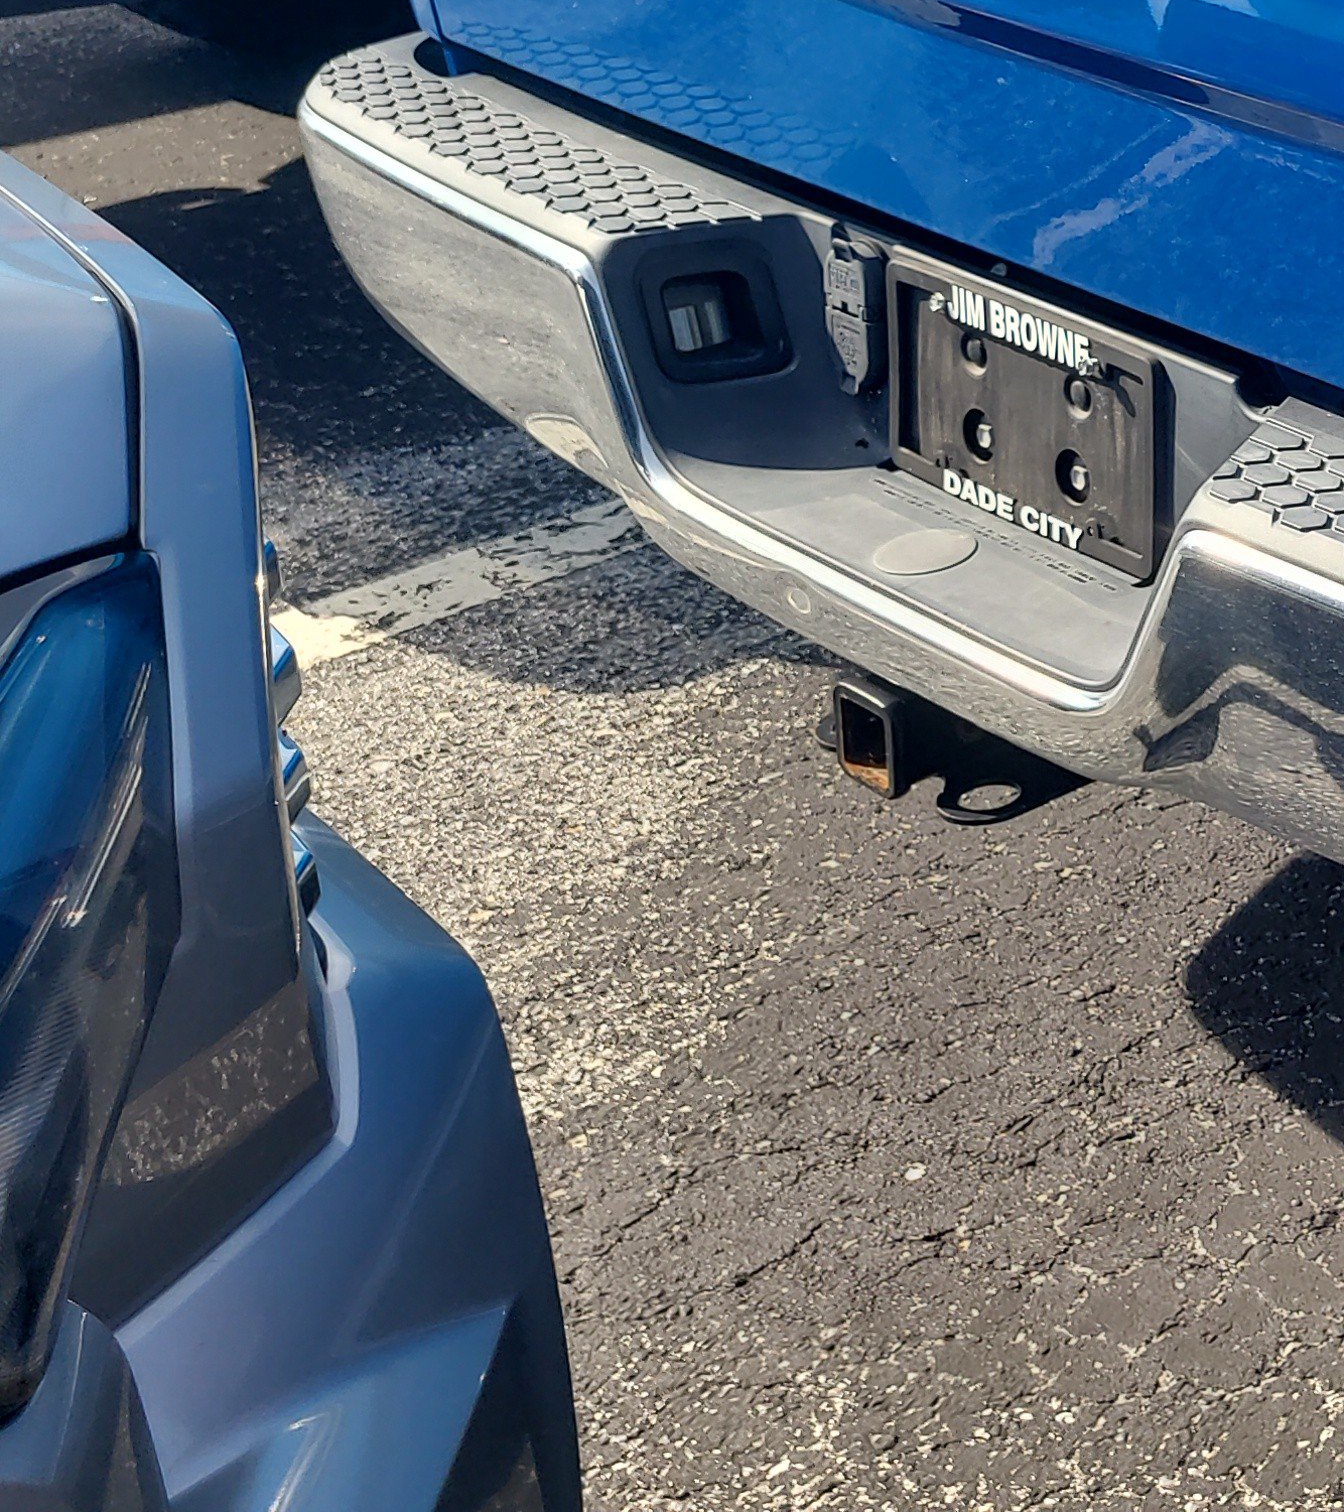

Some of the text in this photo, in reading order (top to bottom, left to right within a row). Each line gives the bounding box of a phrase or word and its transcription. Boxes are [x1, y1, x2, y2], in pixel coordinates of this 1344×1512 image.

[947, 285, 1090, 370] JIM BROWNE
[943, 468, 1014, 523] DADE
[1020, 506, 1083, 551] CITY
